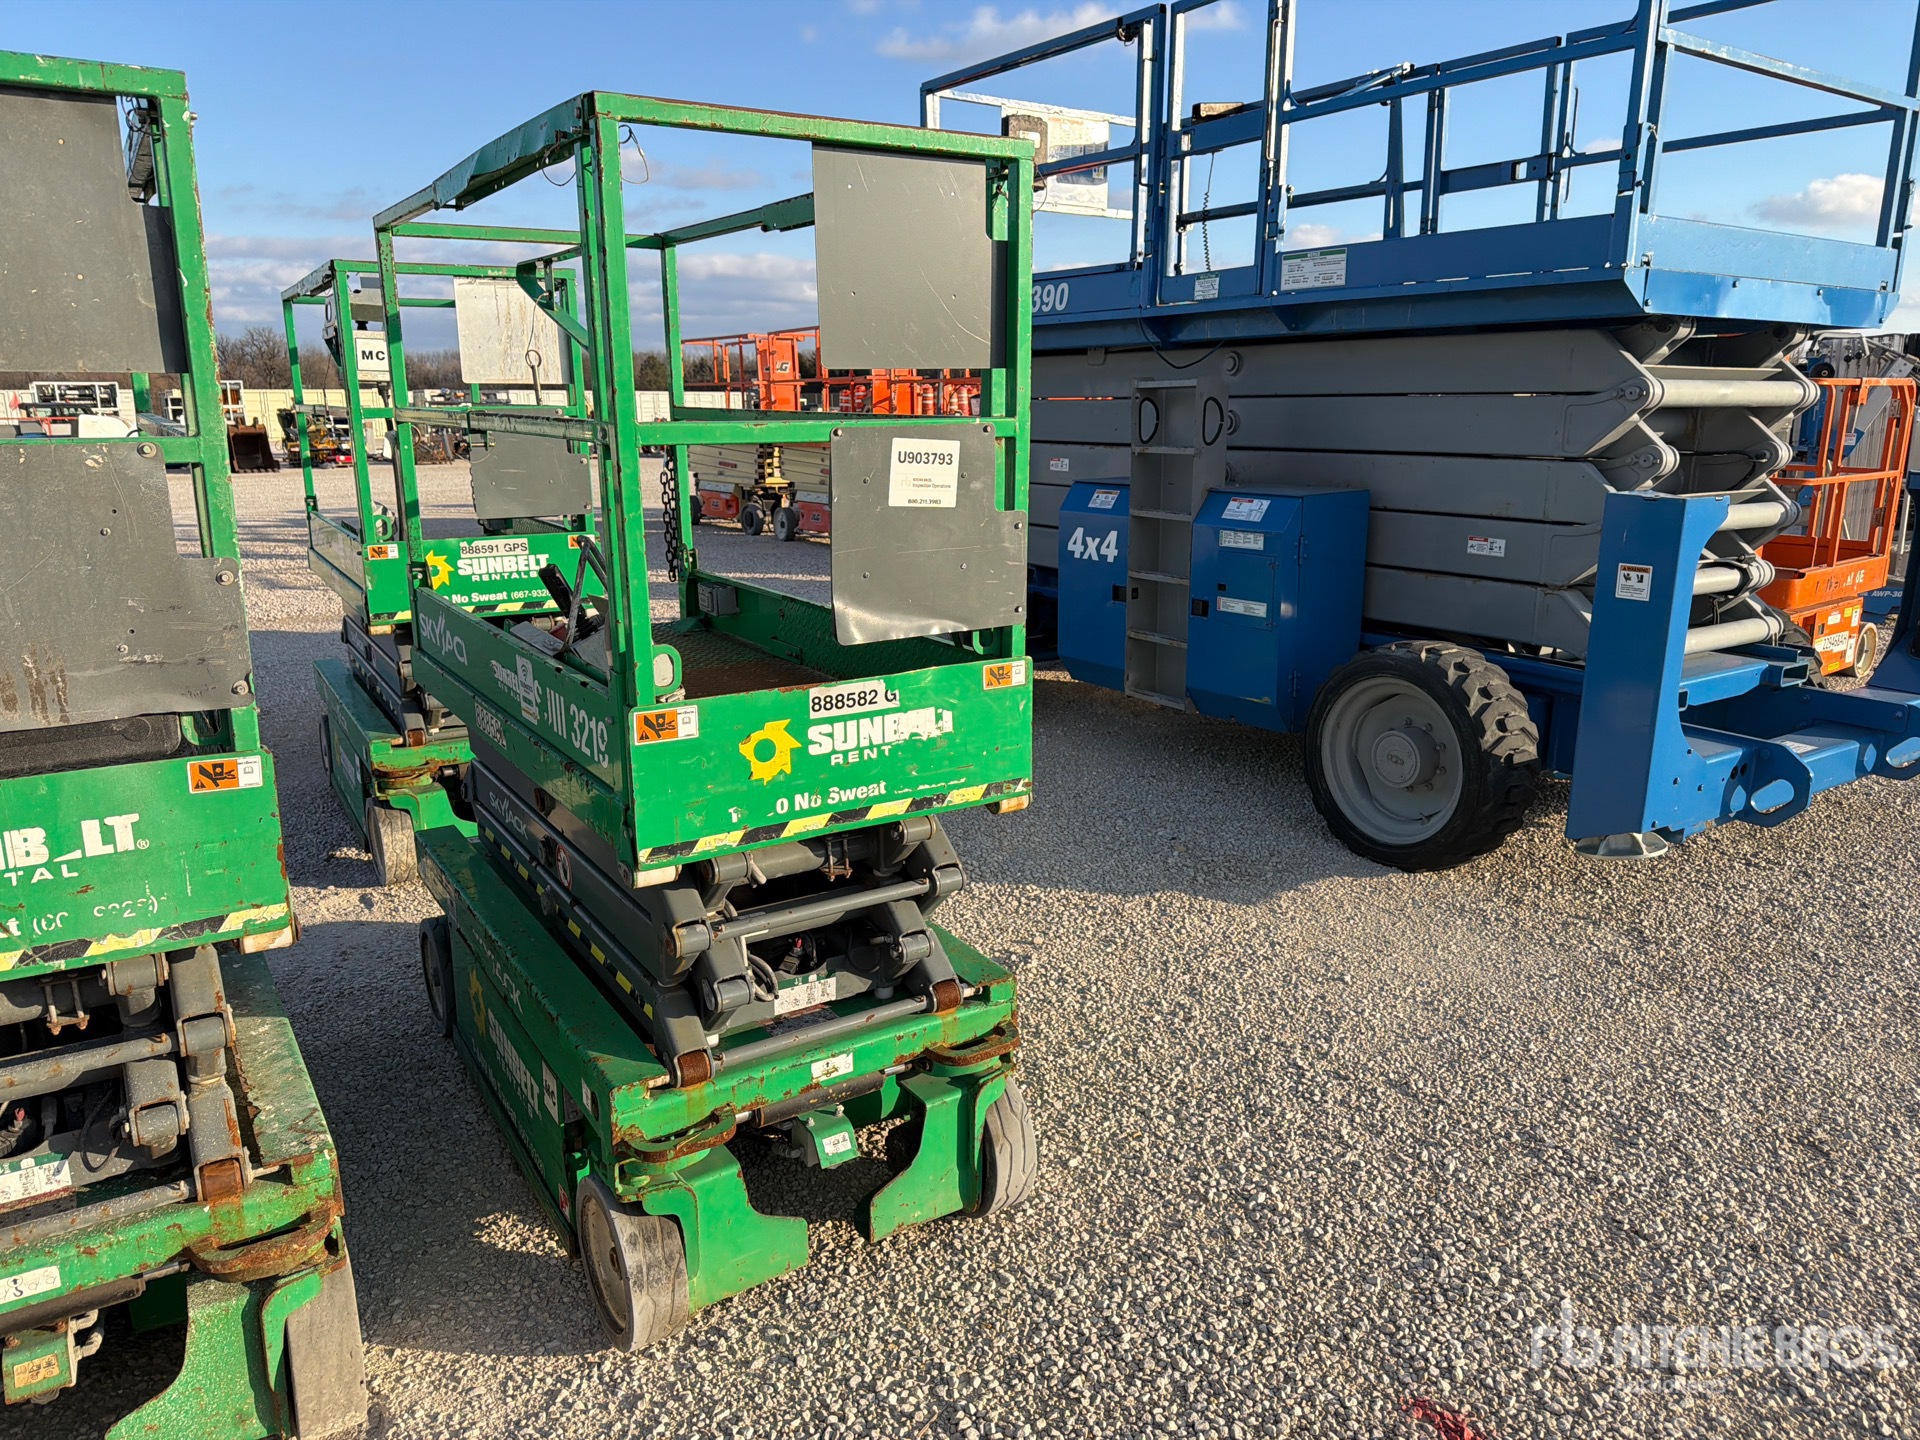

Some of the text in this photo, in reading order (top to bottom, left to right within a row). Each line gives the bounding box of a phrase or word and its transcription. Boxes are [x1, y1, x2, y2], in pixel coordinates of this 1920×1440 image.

[1032, 282, 1069, 313] 390
[361, 350, 385, 361] MC
[898, 450, 953, 465] U903793
[461, 542, 528, 555] 888591 GPS
[1067, 527, 1119, 563] 4x4
[457, 553, 549, 576] SUNBELT
[471, 570, 538, 582] RENTALS
[452, 594, 469, 604] No
[471, 591, 508, 602] Sweat
[1871, 590, 1903, 598] AWP-30
[811, 689, 879, 713] 888582
[570, 703, 609, 769] 3219
[794, 791, 822, 811] No
[827, 779, 887, 804] Sweat
[487, 1007, 540, 1117] SUNBELT
